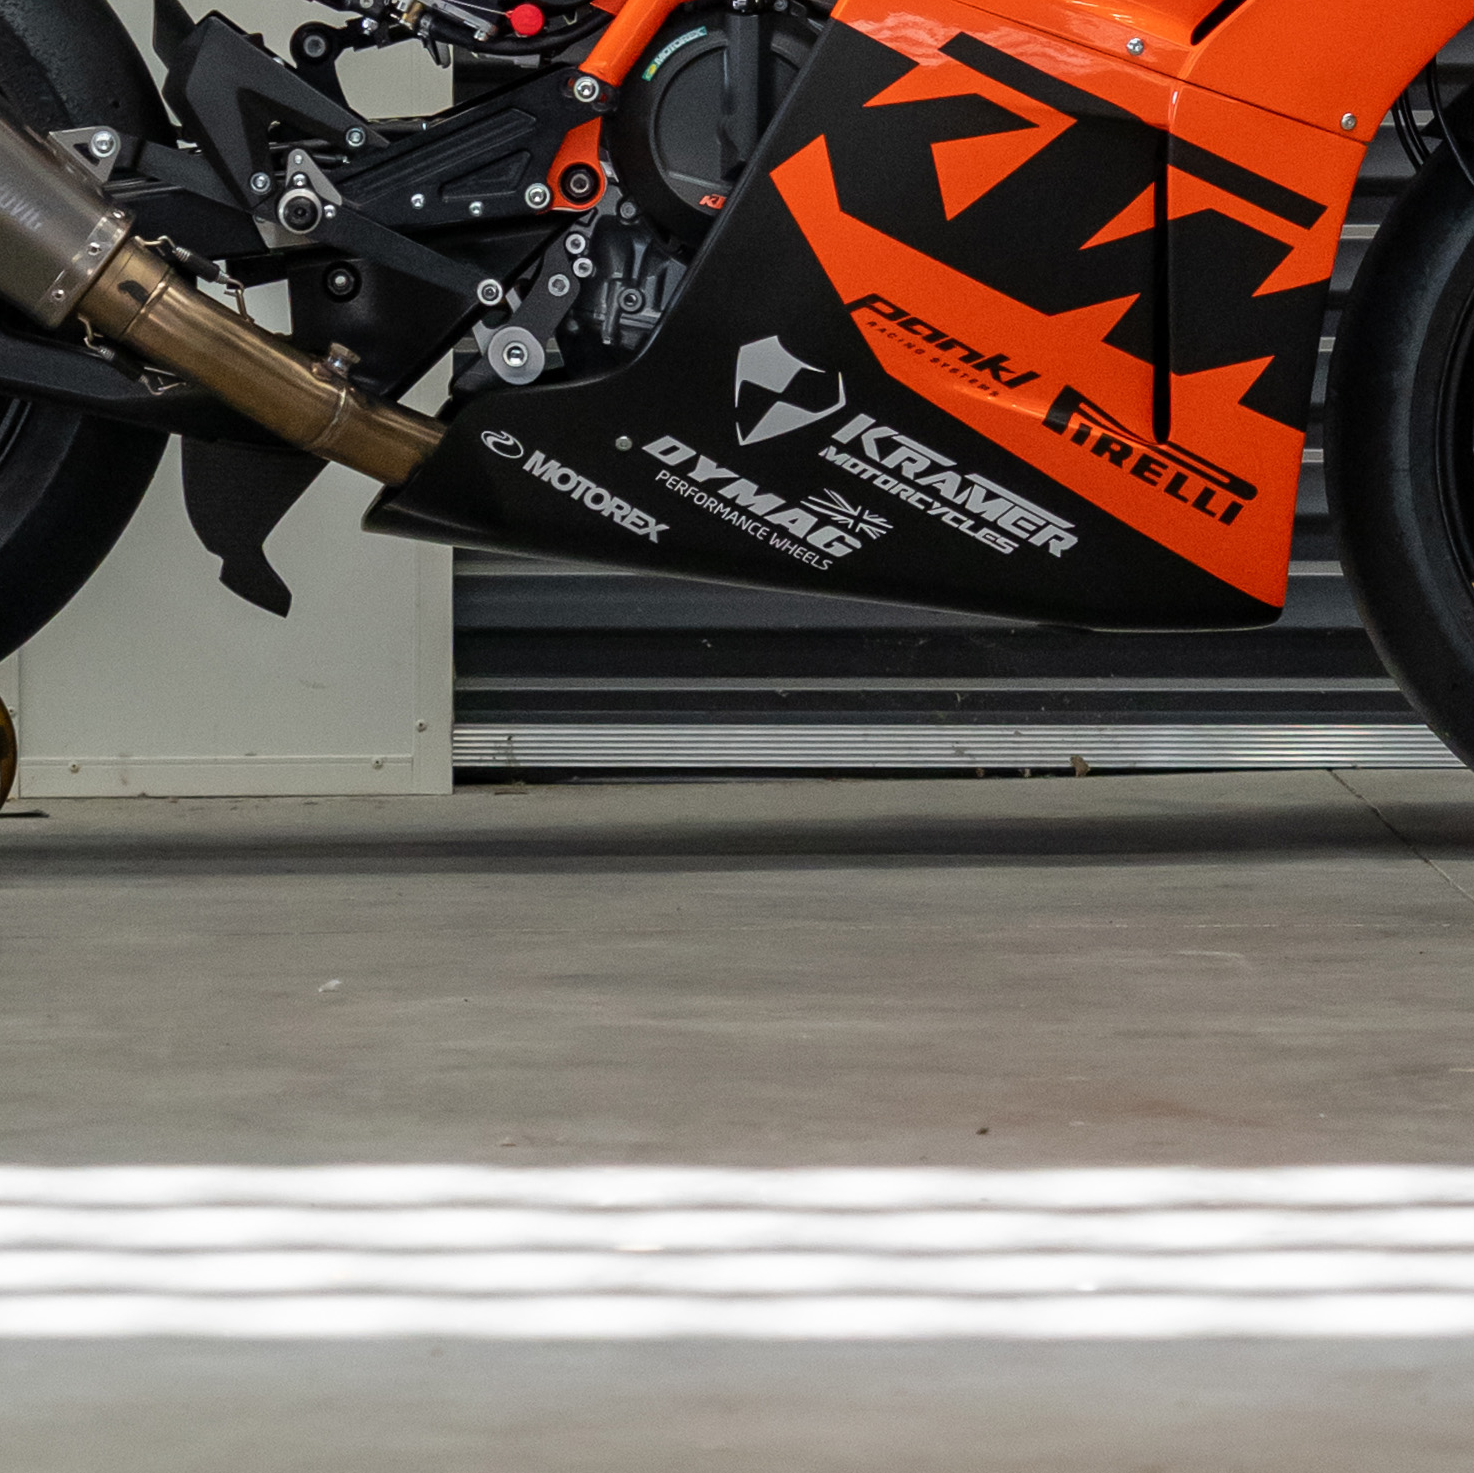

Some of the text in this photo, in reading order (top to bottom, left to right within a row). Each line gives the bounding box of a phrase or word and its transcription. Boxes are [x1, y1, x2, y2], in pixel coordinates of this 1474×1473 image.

[737, 17, 1330, 433] KTM
[867, 320, 1000, 397] RACING SYSTEMS
[522, 449, 670, 544] MOTOREX
[641, 425, 862, 557] DYMAG
[818, 445, 1019, 555] MOTORCYCLES
[1042, 384, 1258, 526] PIRELLI
[655, 469, 833, 571] PERFORMANCE WHEELS
